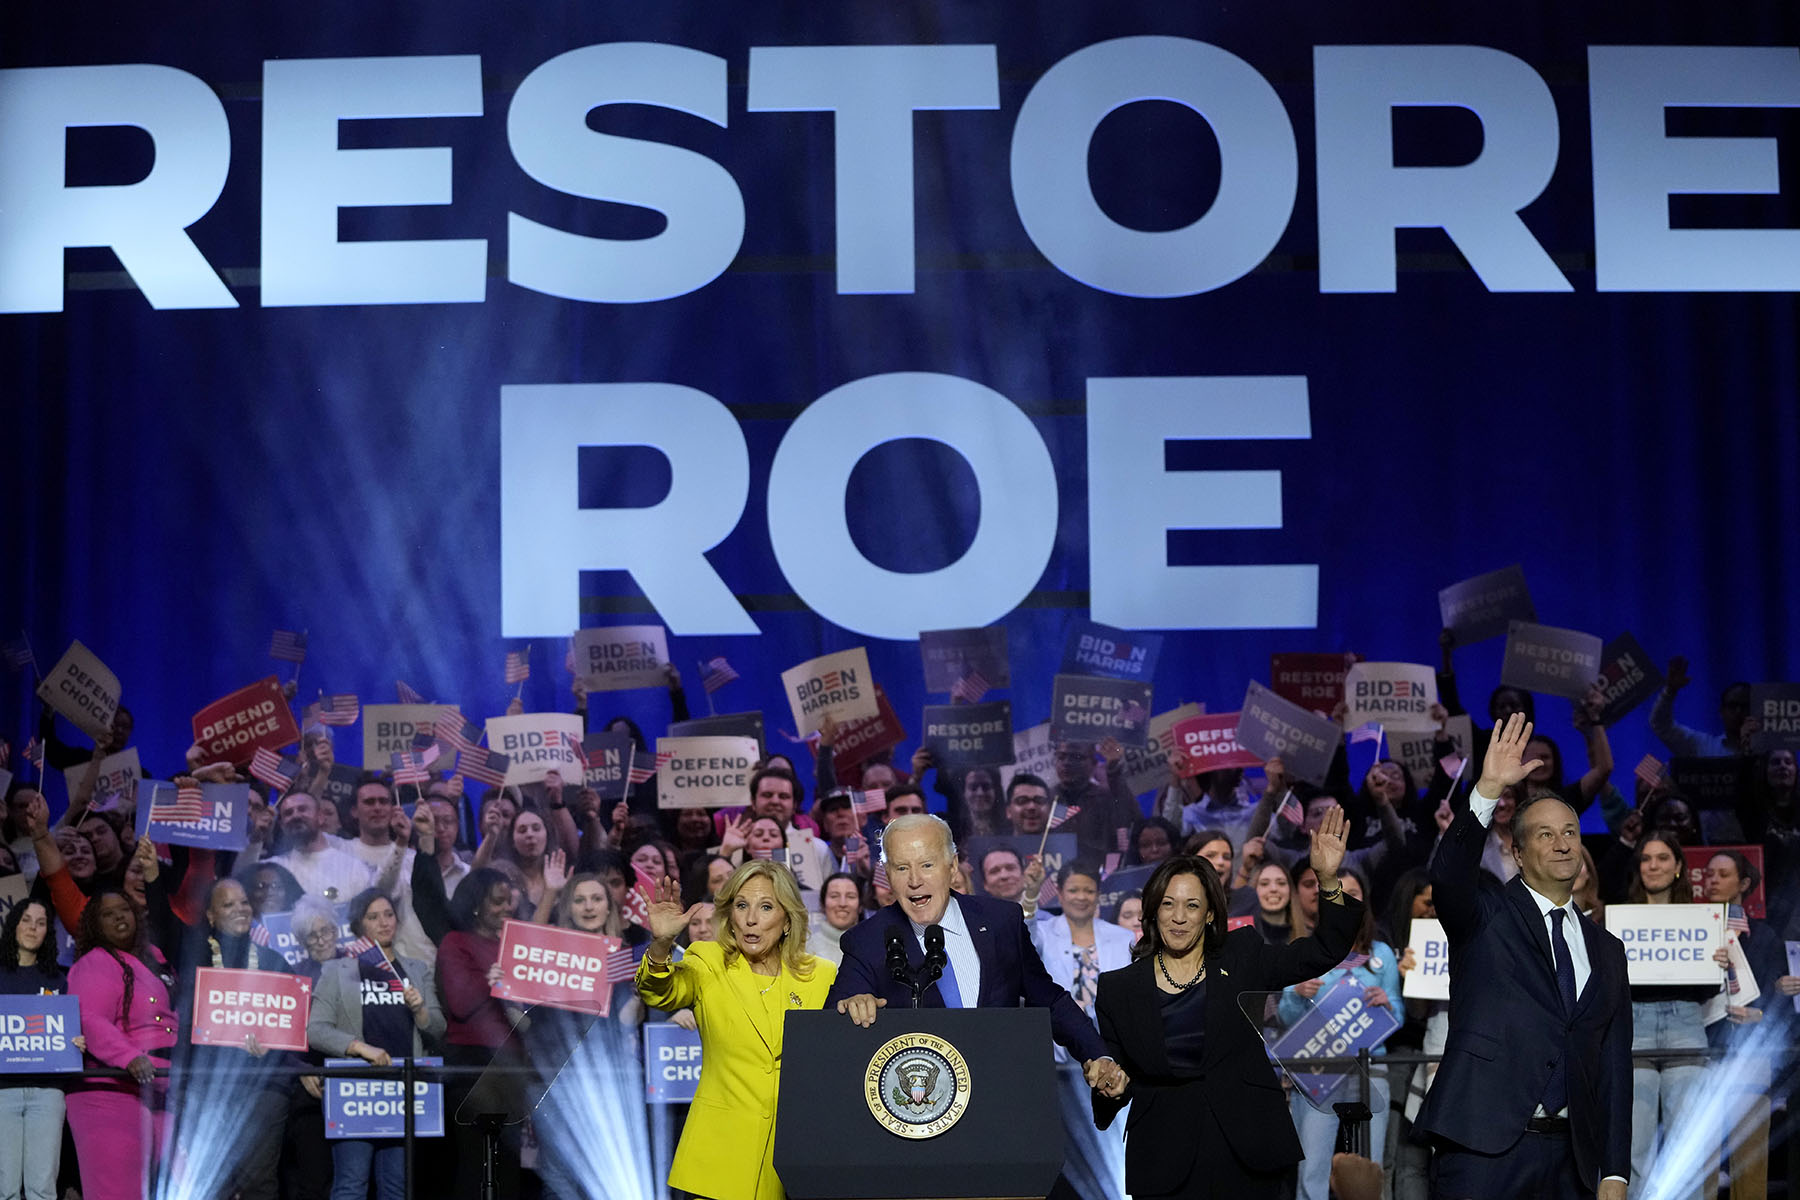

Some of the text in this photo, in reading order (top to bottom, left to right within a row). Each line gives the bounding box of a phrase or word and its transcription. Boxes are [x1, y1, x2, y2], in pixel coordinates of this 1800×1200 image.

[0, 35, 1800, 313] RESTORE
[500, 371, 1320, 640] ROE
[589, 642, 656, 660] BIDEN
[1514, 641, 1595, 667] RESTORE
[591, 657, 657, 674] HARRIS
[1076, 650, 1143, 673] HARRIS
[1535, 662, 1570, 679] ROE
[1280, 672, 1345, 684] RESTOR
[1596, 652, 1636, 691] DEN
[797, 669, 857, 701] BIDEN
[1301, 686, 1336, 698] ROE
[1355, 680, 1426, 698] BIDEN
[1604, 666, 1645, 704] RRIS
[60, 680, 110, 725] CHOICE
[801, 686, 860, 715] HARRIS
[1355, 699, 1427, 713] HARRIS
[1763, 700, 1800, 717] BID
[202, 700, 275, 741] DEFEND
[928, 720, 1004, 736] RESTORE
[1249, 704, 1328, 753] RESTORE
[211, 717, 280, 755] CHOICE
[378, 722, 436, 738] BIDE
[832, 720, 887, 757] HOICE
[1184, 728, 1238, 744] DEFE
[504, 730, 573, 751] BIDEN
[948, 738, 984, 751] ROE
[1190, 741, 1247, 757] CHOI
[1264, 731, 1298, 756] ROE
[504, 748, 575, 764] HARRIS
[671, 757, 748, 771] DEFEND
[585, 767, 622, 783] RRIS
[674, 775, 747, 789] CHOICE
[152, 818, 232, 833] RRIS
[1621, 929, 1708, 942] DEFEND
[512, 943, 602, 973] DEFEND
[1626, 948, 1705, 961] CHOICE
[512, 964, 596, 992] CHOICE
[208, 989, 298, 1011] DEFEND
[361, 992, 405, 1006] ARR
[0, 1014, 65, 1034] IDEN
[210, 1009, 293, 1029] CHOICE
[0, 1035, 66, 1051] ARRIS
[930, 1041, 944, 1050] THE
[1311, 1011, 1374, 1074] HOICE
[659, 1046, 702, 1062] DEF
[869, 1037, 916, 1083] PRESIDENT
[663, 1065, 702, 1081] CHO
[945, 1050, 968, 1093] UNITED
[873, 1101, 882, 1111] OF
[880, 1112, 908, 1134] SEAL
[927, 1102, 963, 1134] STATES
